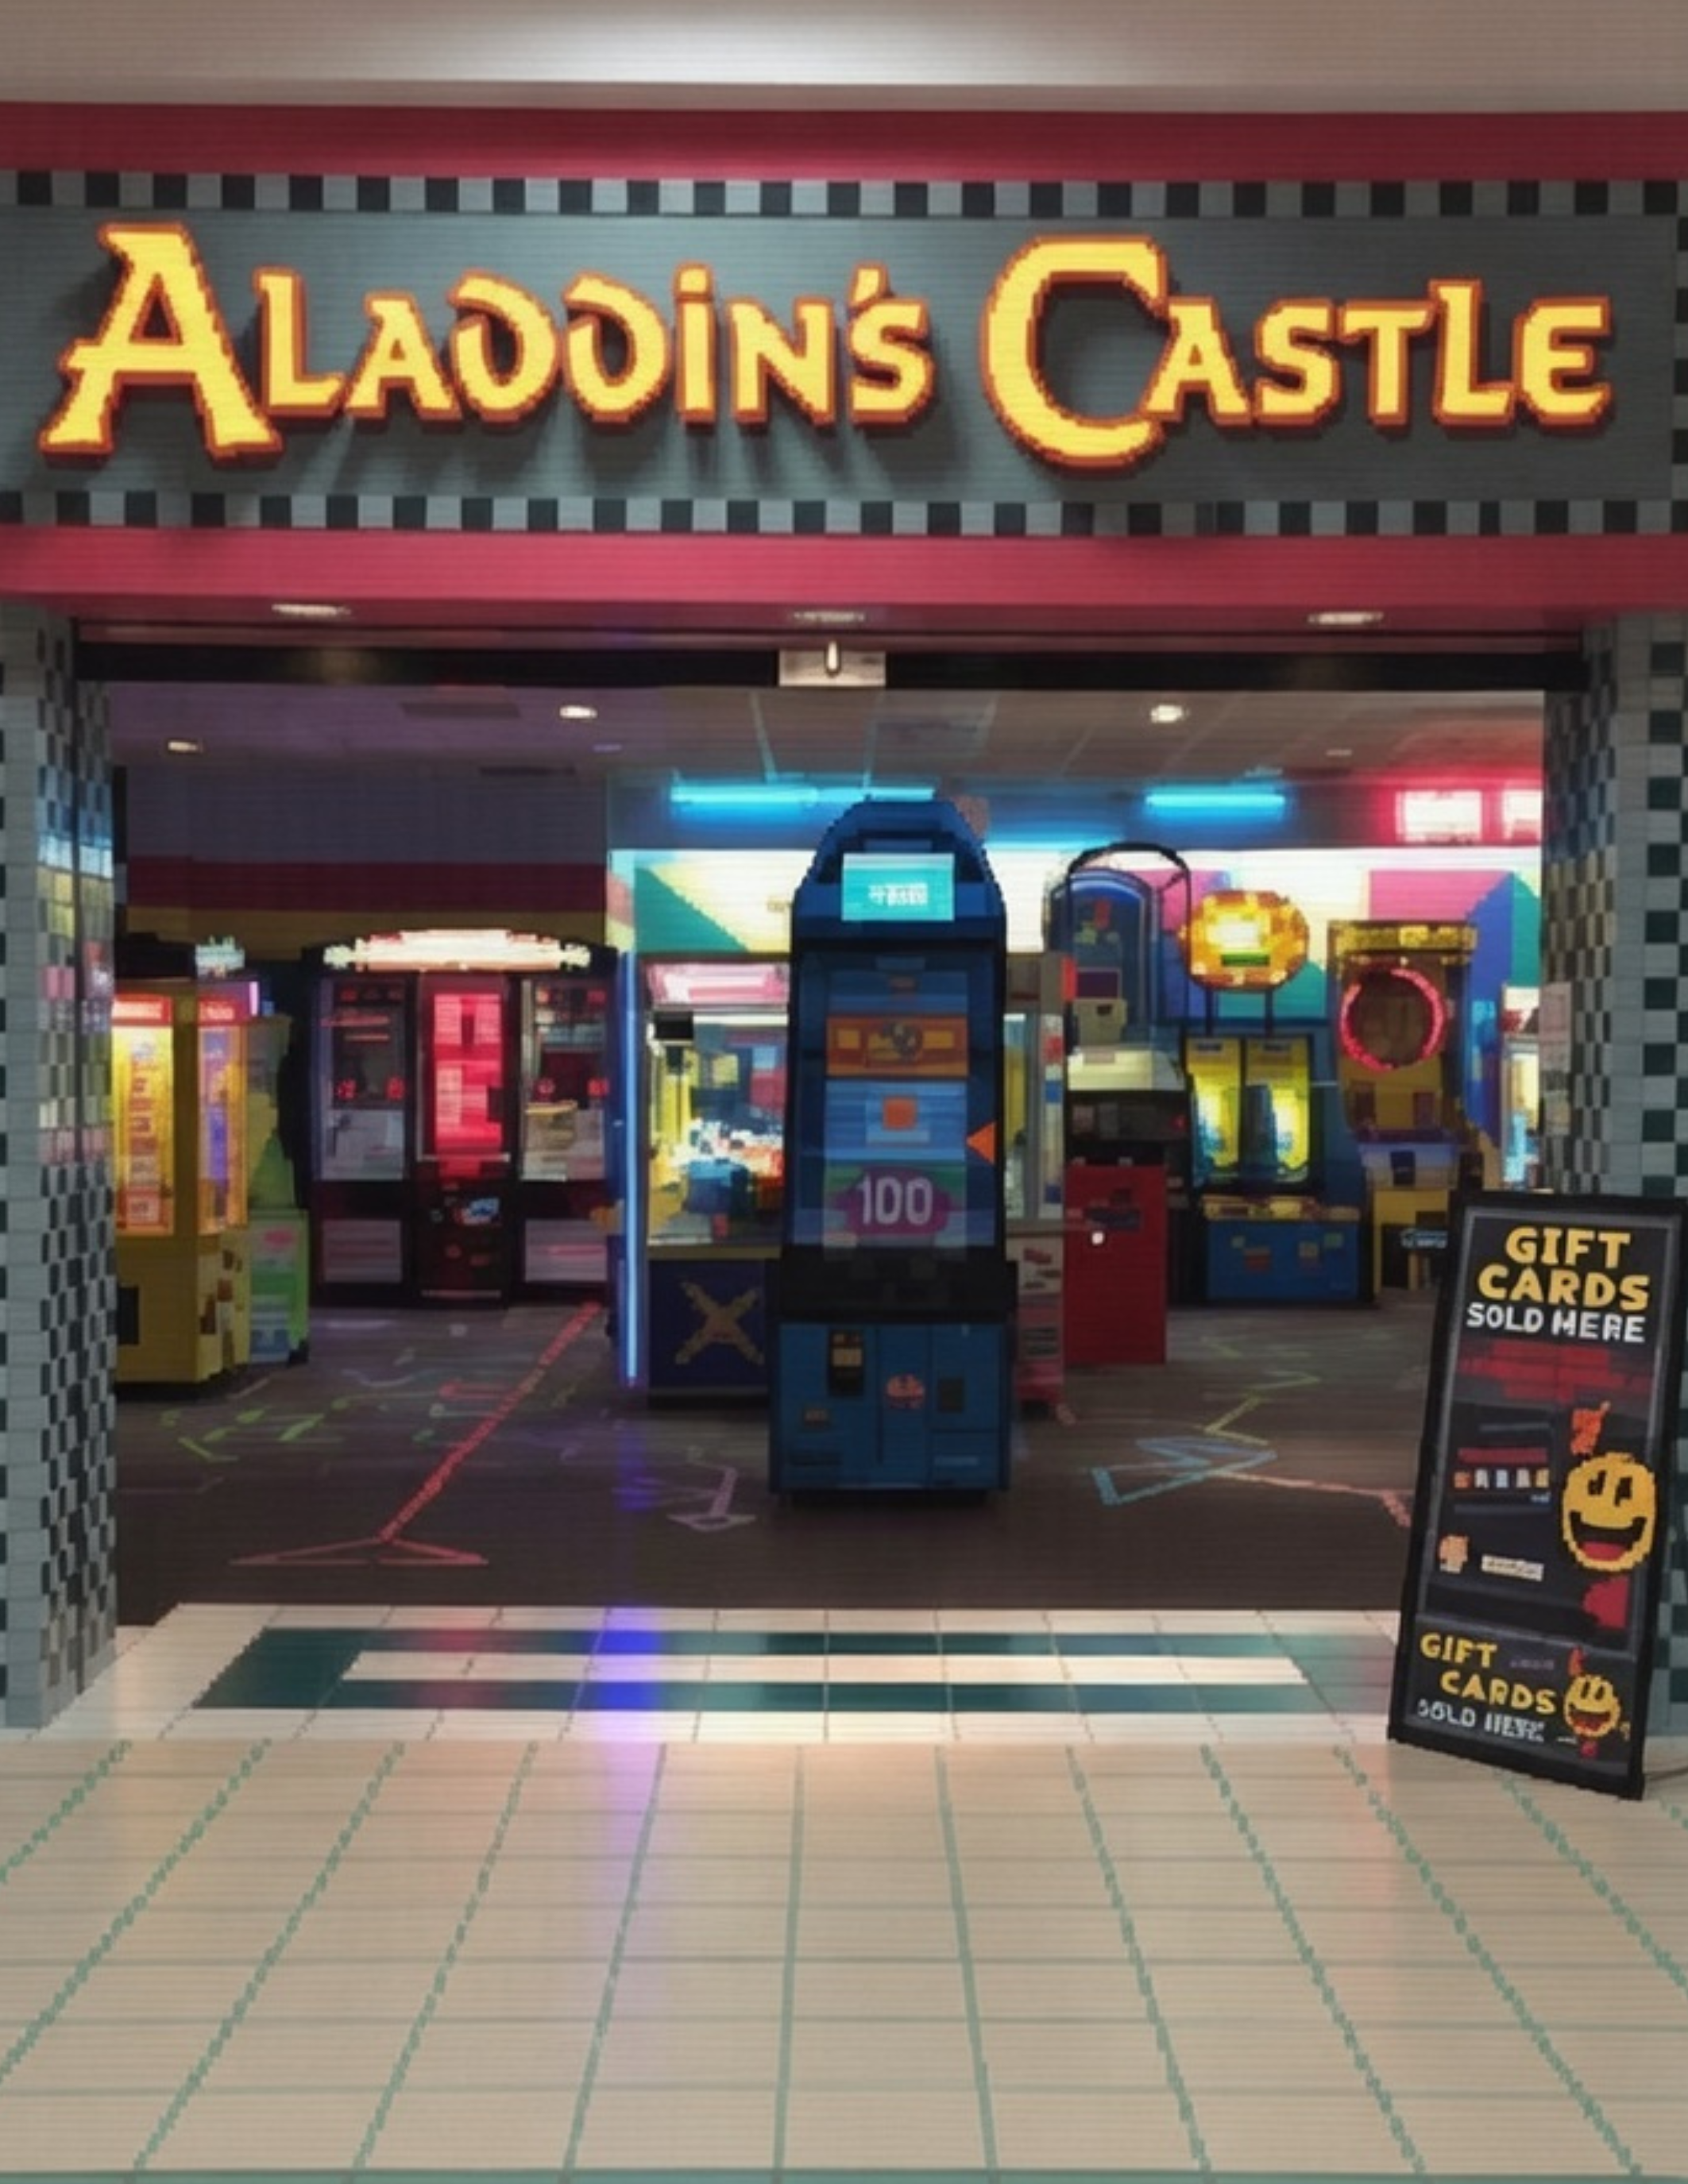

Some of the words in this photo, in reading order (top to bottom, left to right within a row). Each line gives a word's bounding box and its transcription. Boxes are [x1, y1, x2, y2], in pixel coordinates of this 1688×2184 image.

[980, 232, 1612, 469] CASTLE
[855, 1175, 933, 1225] 100
[1505, 1227, 1632, 1269] GIFT
[1477, 1263, 1650, 1311] CARDS
[1466, 1302, 1544, 1333] SOLD
[1420, 1632, 1498, 1668] GIFT
[1440, 1670, 1557, 1715] CARDS
